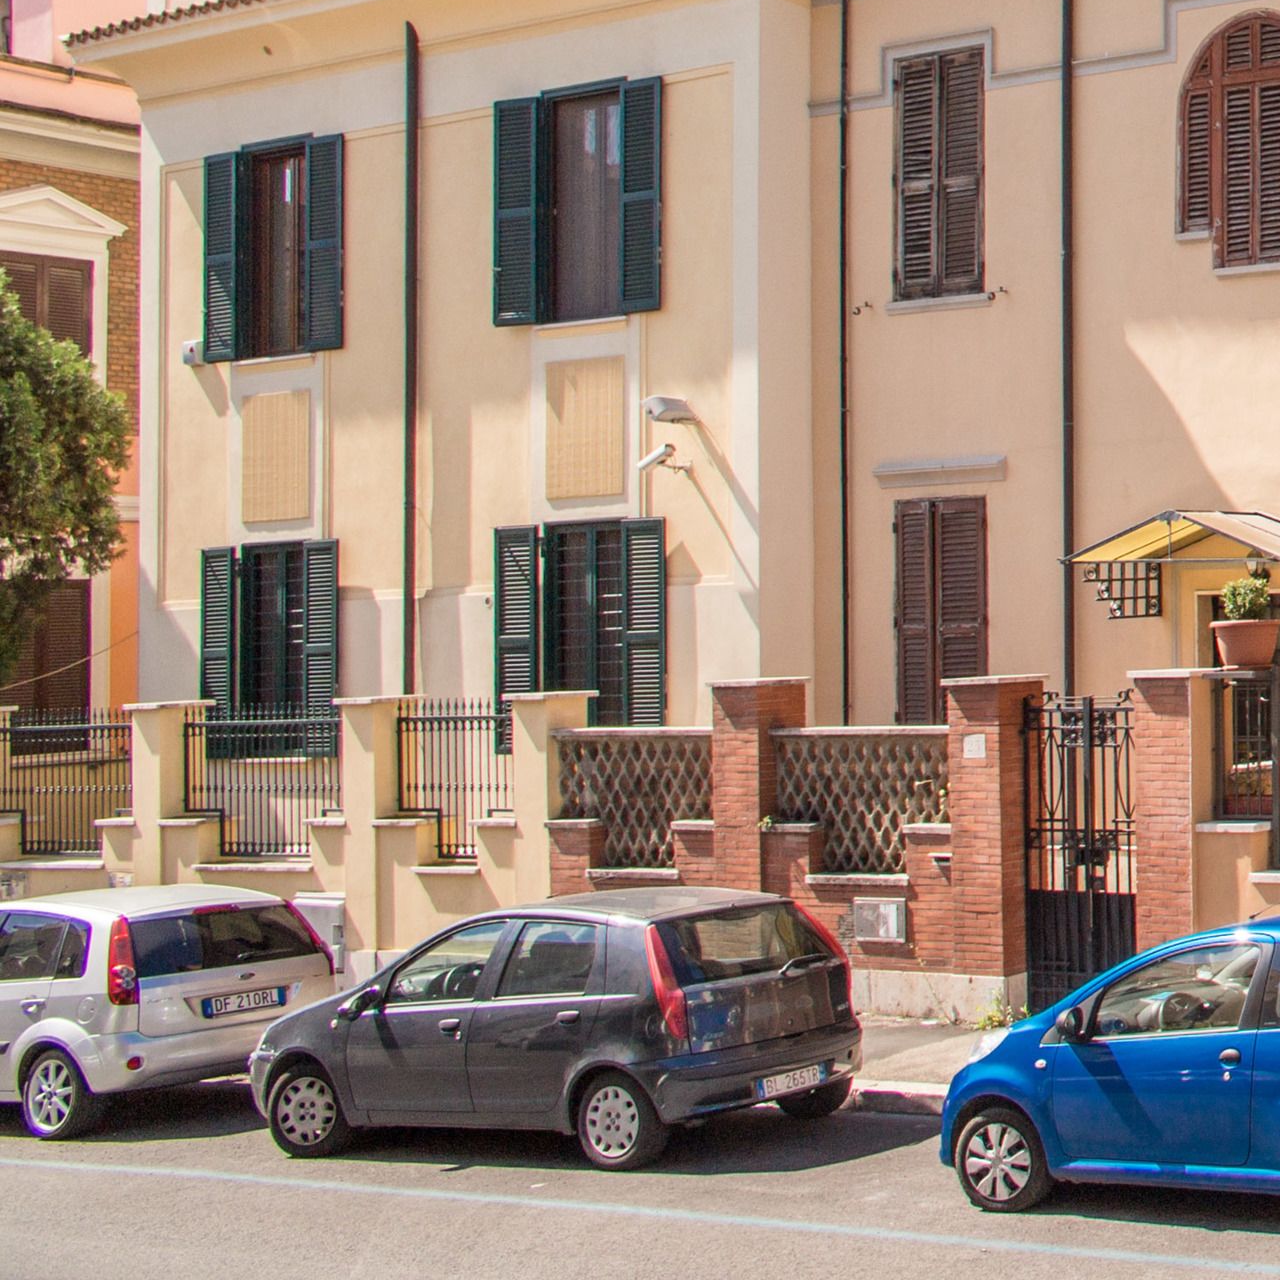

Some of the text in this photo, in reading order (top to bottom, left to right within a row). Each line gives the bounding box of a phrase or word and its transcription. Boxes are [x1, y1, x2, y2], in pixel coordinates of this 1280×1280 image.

[214, 990, 277, 1013] DF 210RL
[765, 1067, 819, 1094] BL 265TR
